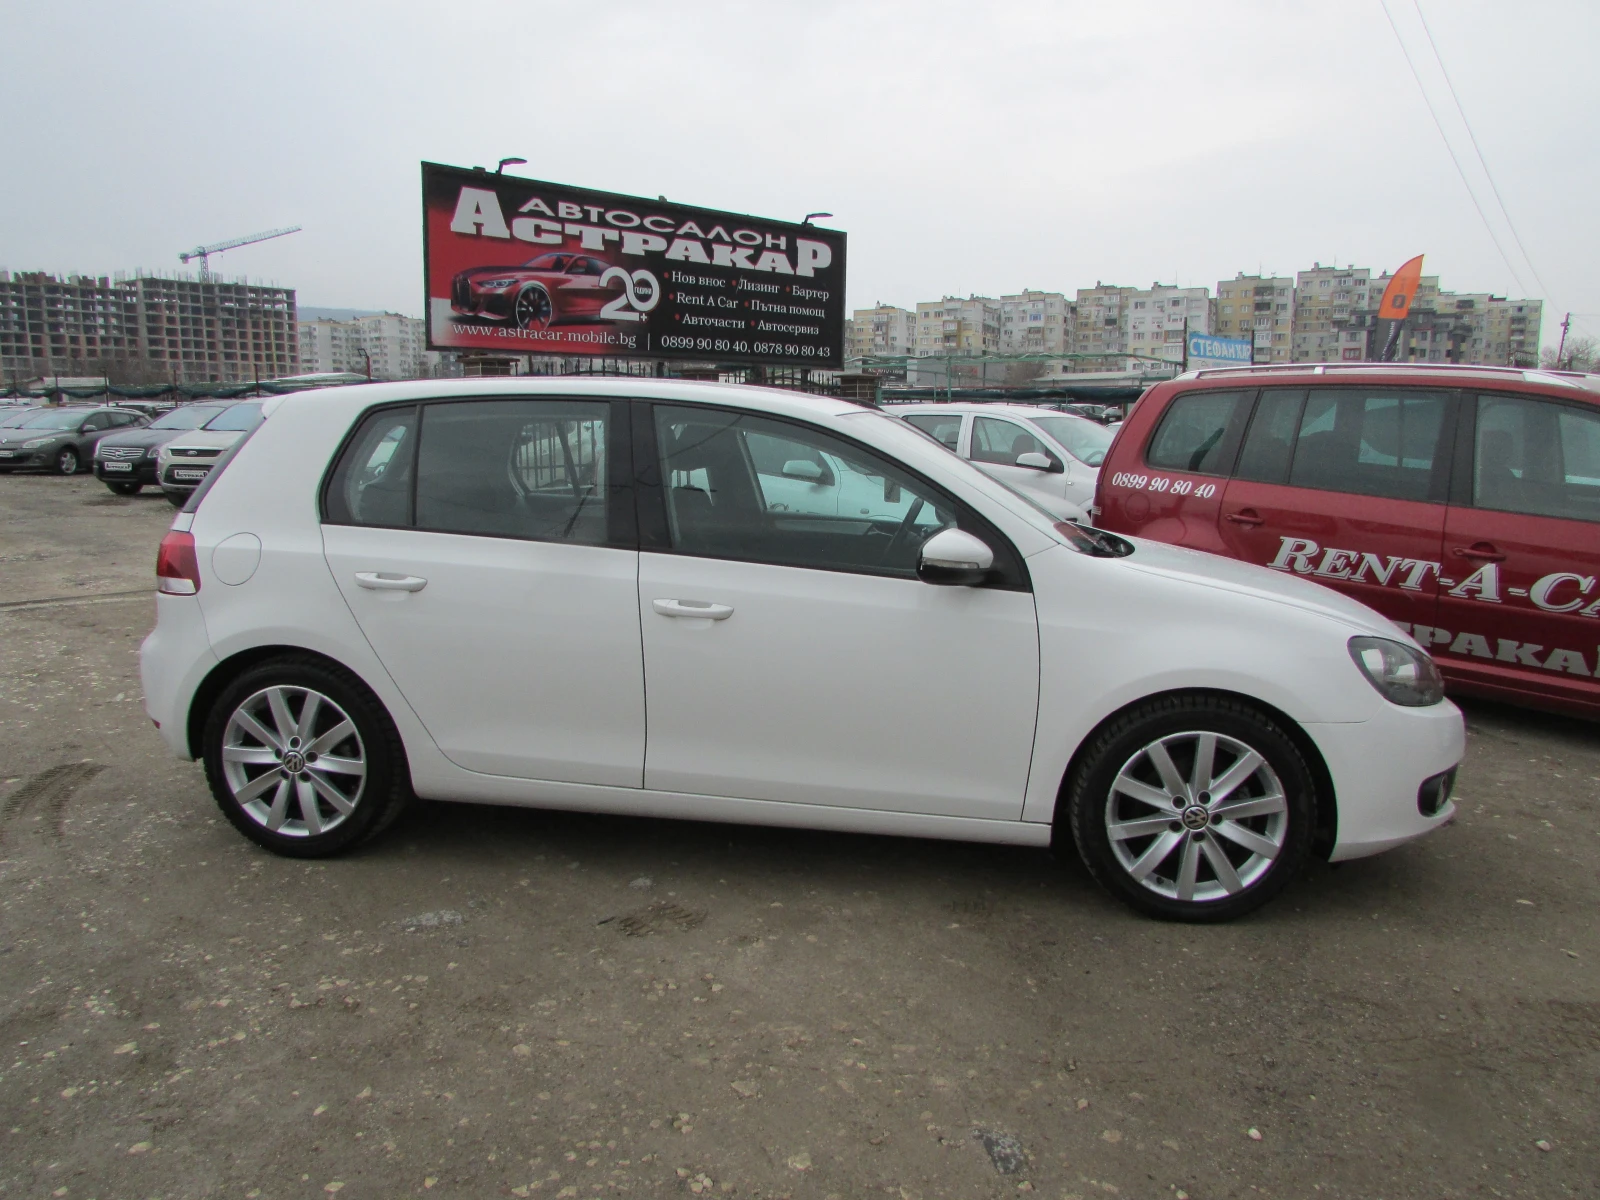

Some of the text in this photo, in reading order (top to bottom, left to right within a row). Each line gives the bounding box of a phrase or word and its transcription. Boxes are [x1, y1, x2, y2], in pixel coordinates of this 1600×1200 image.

[451, 186, 832, 277] АСТРАКАР
[518, 198, 787, 250] АВТОСАЛОН
[671, 271, 726, 288] Нов внос
[739, 279, 781, 294] Лизинг
[676, 292, 738, 309] Rent A Car
[792, 285, 830, 301] Бартер
[751, 300, 825, 318] Пътна помощ
[682, 313, 745, 329] Авточасти
[758, 320, 819, 336] Автосервиз
[453, 324, 637, 348] www.astracar.mobile.bg
[661, 336, 694, 349] 0899
[697, 339, 712, 350] 90
[715, 340, 730, 351] 80
[753, 342, 783, 354] 0878
[785, 344, 799, 355] 90
[801, 345, 815, 356] 80
[817, 347, 830, 357] 43
[1112, 471, 1216, 499] 0899 90 80 40
